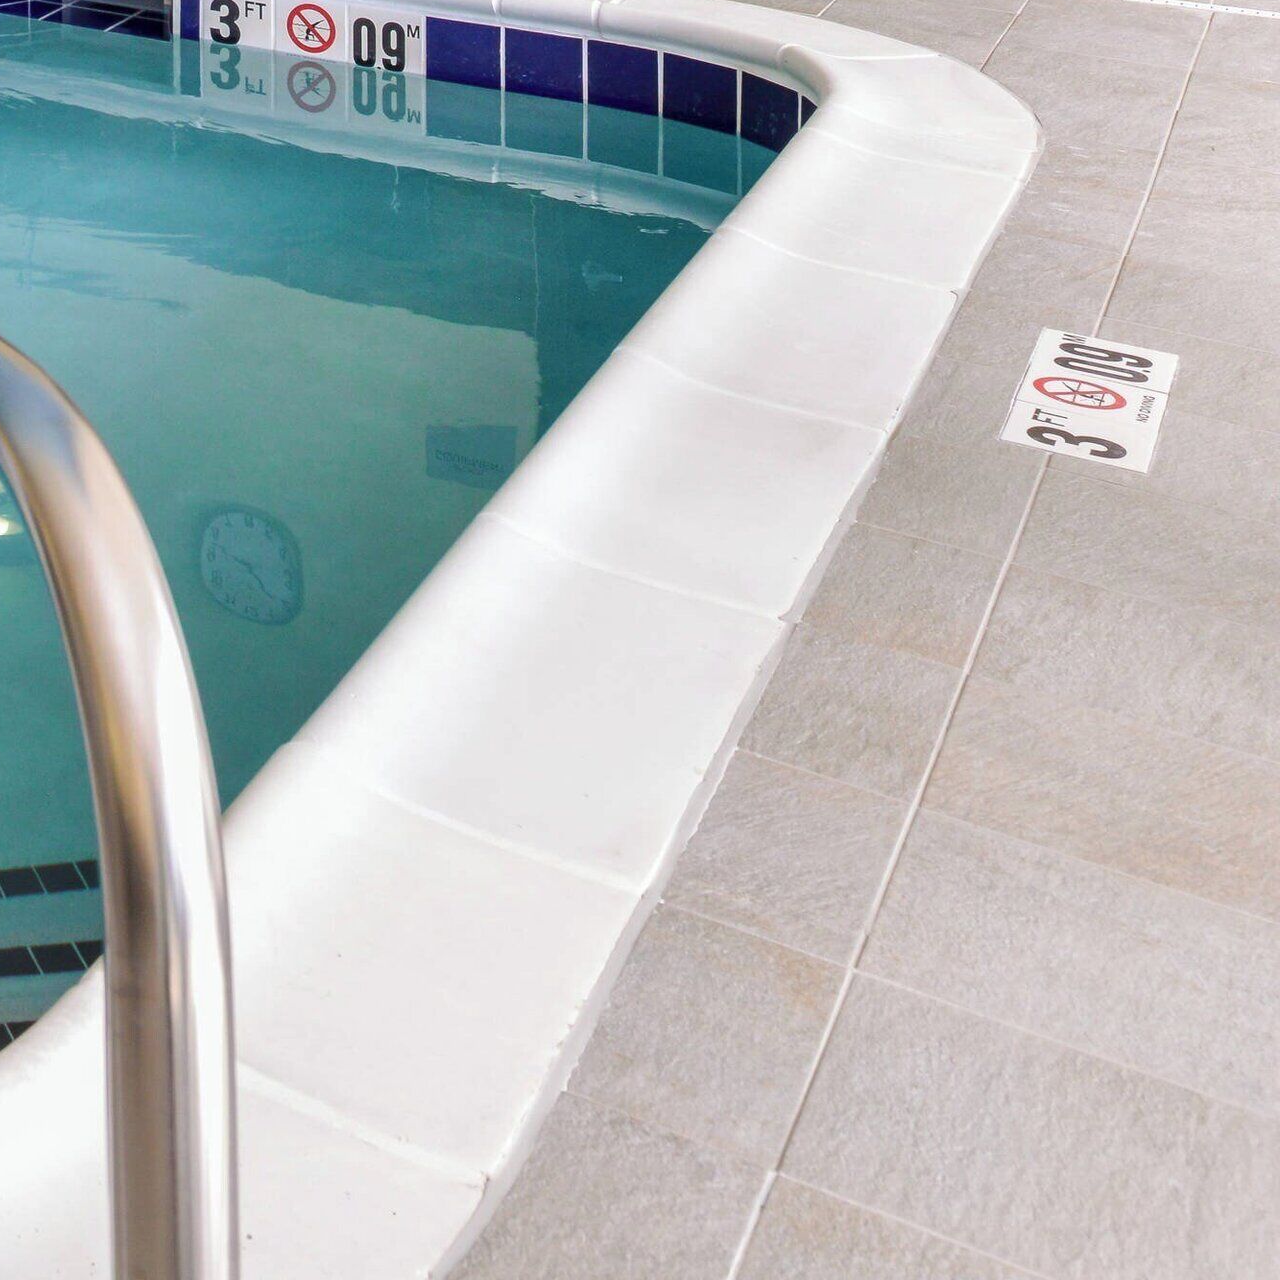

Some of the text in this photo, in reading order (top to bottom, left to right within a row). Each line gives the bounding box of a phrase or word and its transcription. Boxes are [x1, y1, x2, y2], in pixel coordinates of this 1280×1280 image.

[244, 0, 267, 20] FT
[406, 24, 421, 40] M
[1061, 332, 1088, 345] M
[1136, 395, 1156, 424] NO DIVING
[1026, 407, 1128, 460] 3 FT
